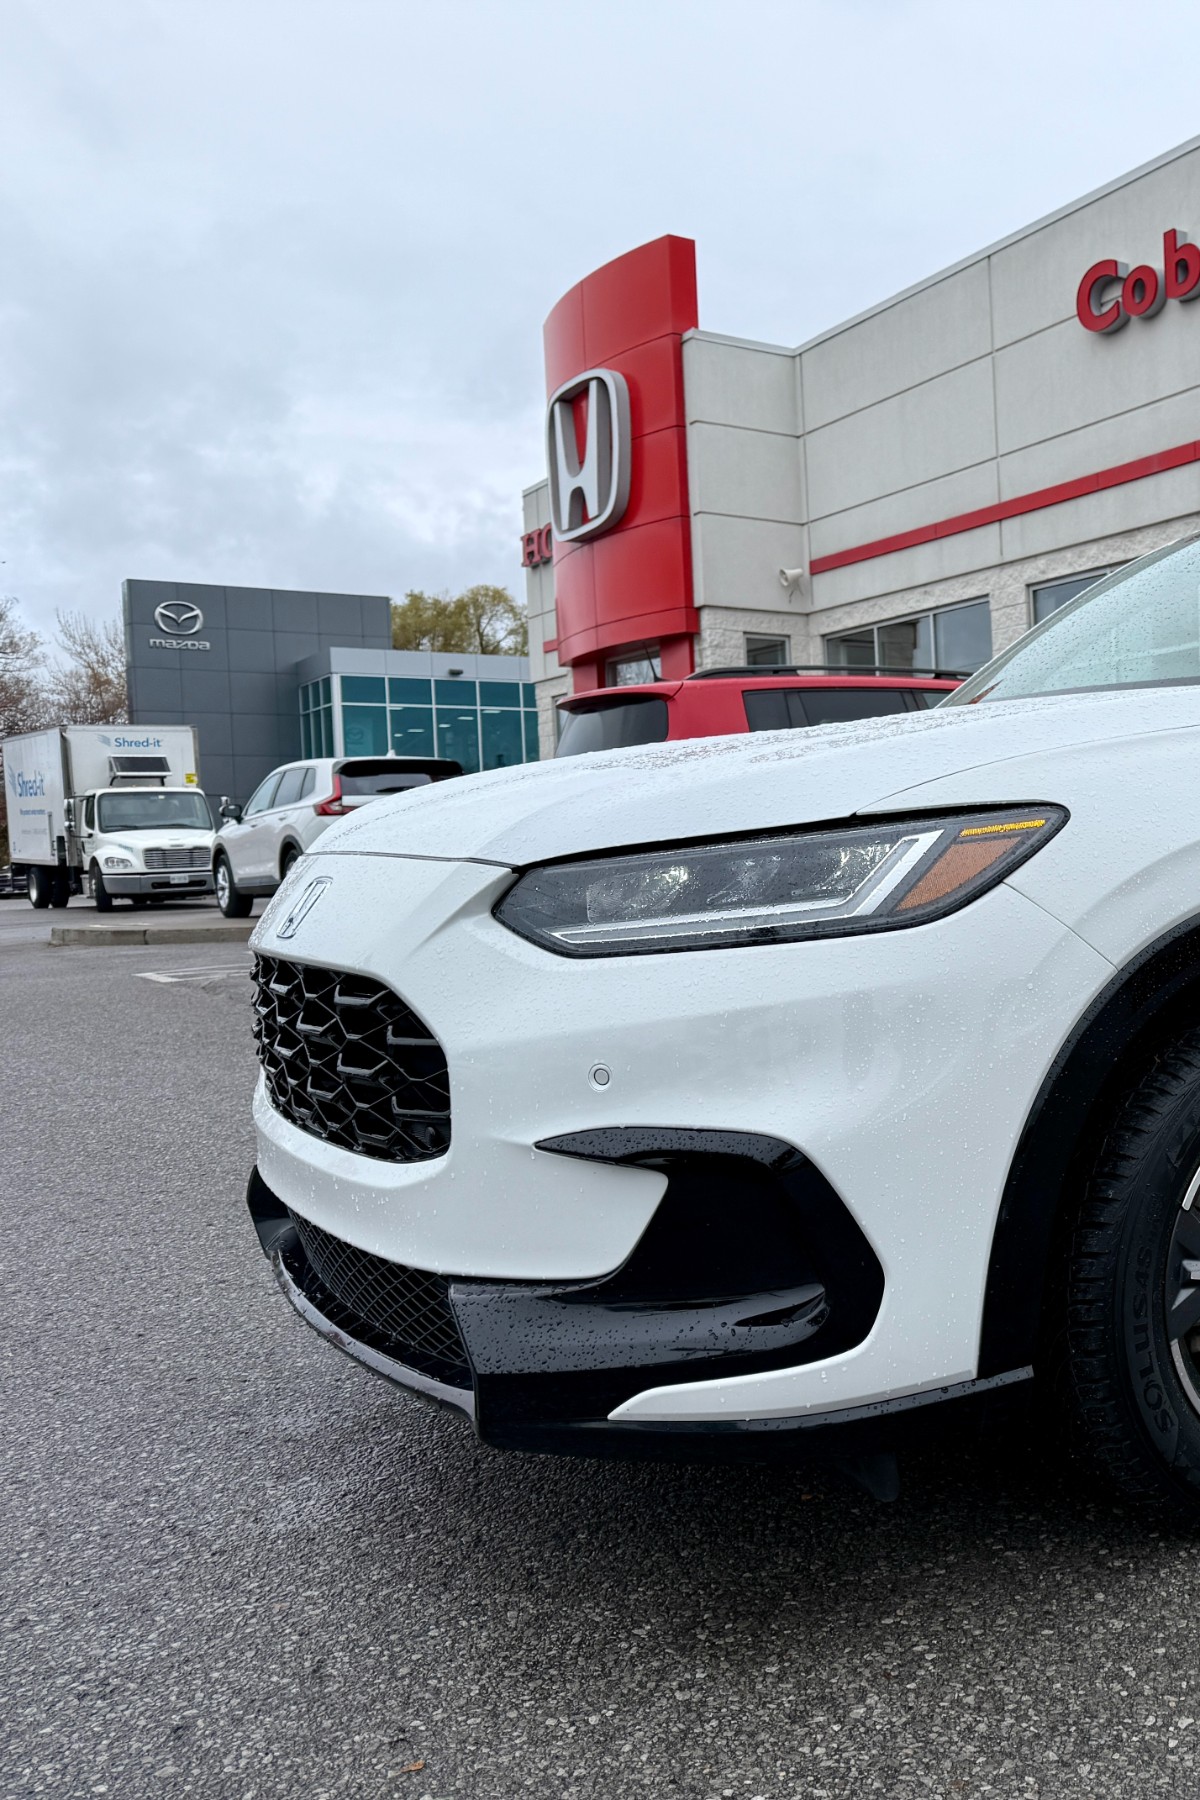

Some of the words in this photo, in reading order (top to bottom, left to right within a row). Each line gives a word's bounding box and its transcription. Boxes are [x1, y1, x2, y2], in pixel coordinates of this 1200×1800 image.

[149, 638, 211, 651] mazda
[114, 737, 162, 748] Shred-it
[17, 769, 45, 798] Shred-it
[1132, 1293, 1173, 1435] SOLUS
